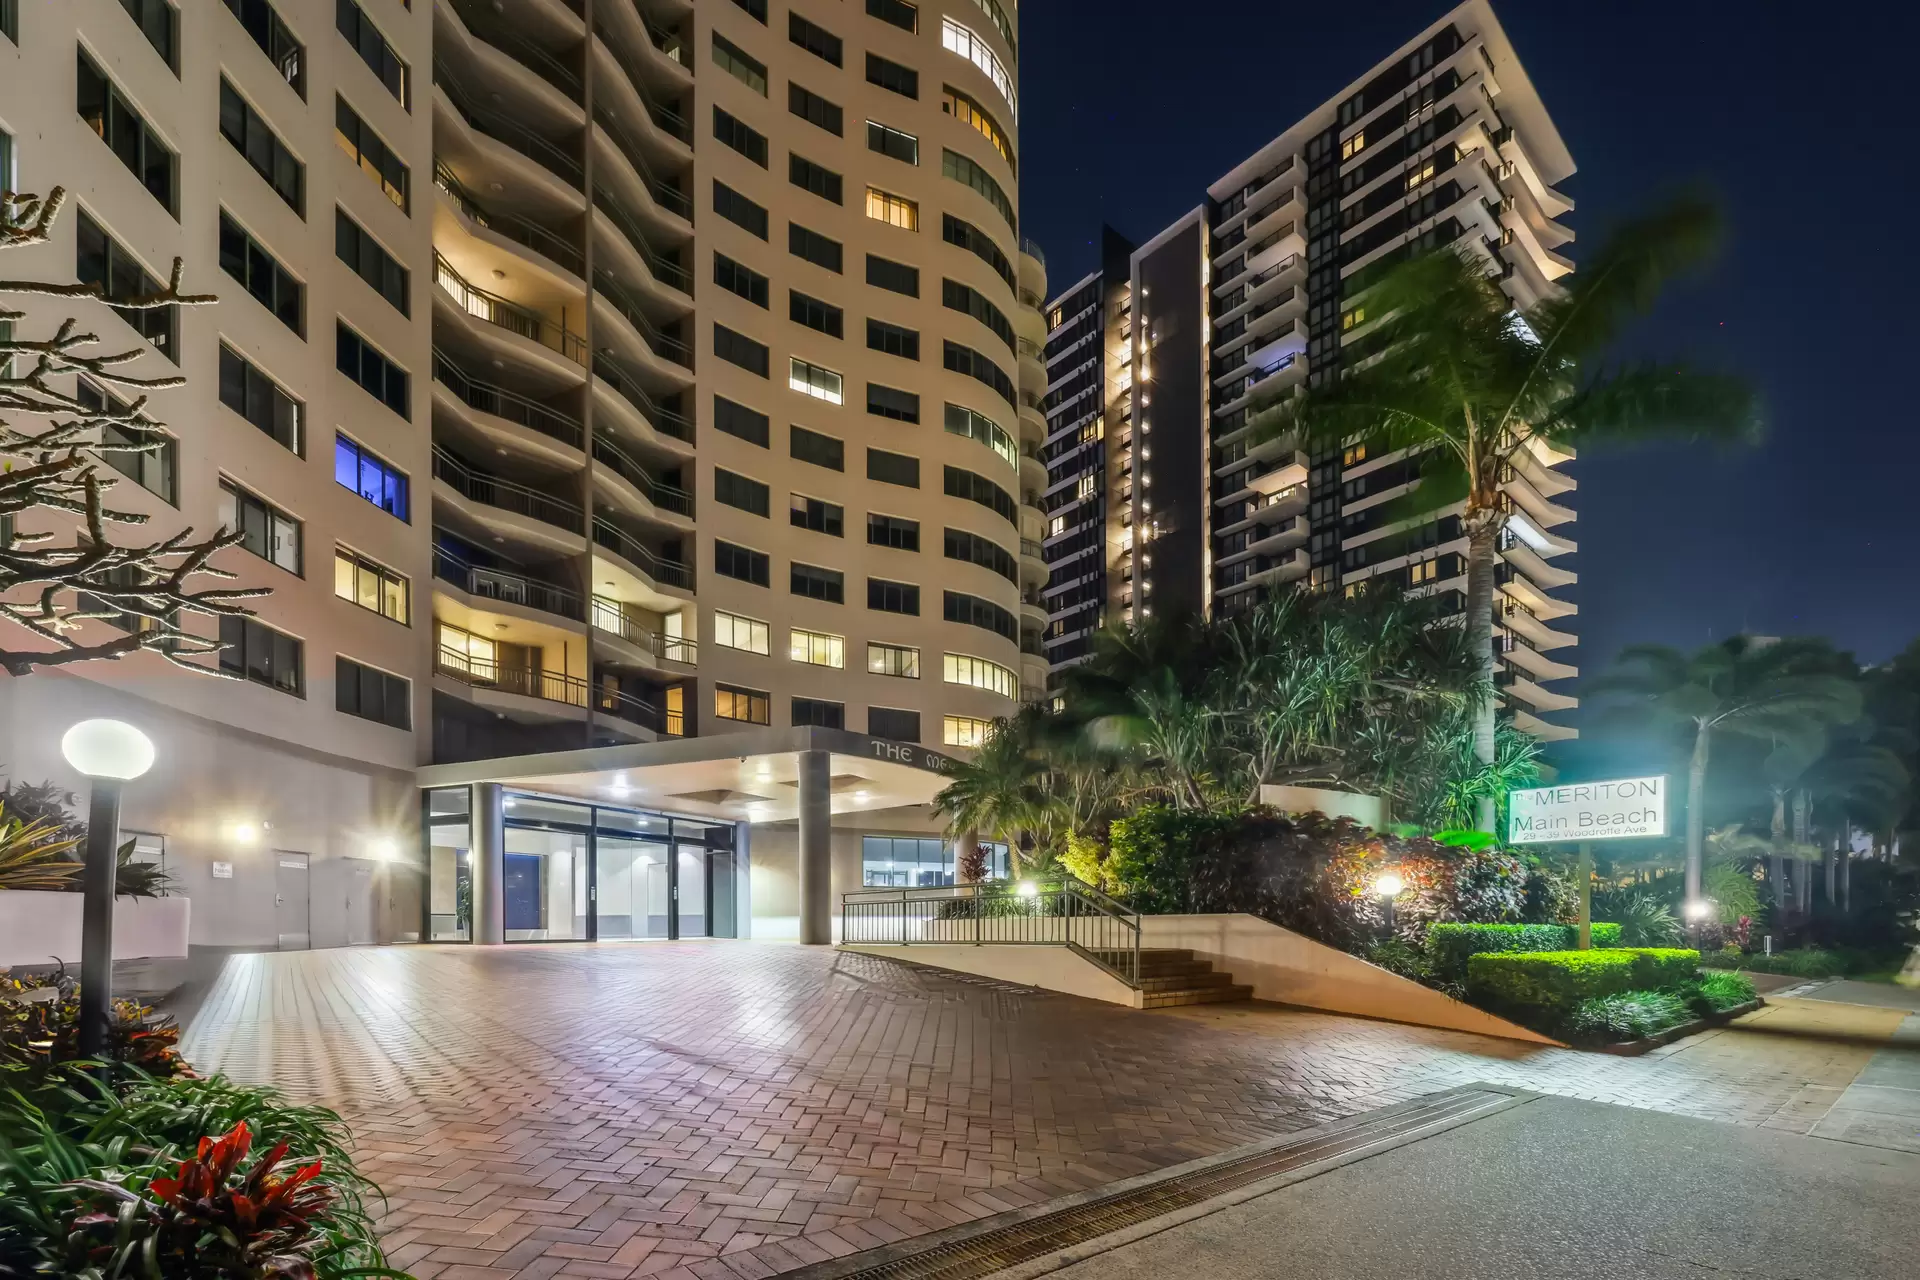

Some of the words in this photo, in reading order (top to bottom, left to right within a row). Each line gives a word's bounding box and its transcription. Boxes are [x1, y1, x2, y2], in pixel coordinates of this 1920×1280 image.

[870, 740, 913, 762] THE
[1535, 779, 1657, 806] MERITON
[1515, 814, 1568, 832] Main
[1578, 807, 1657, 827] Beach
[1523, 832, 1536, 840] 29
[1546, 831, 1560, 839] 39
[1623, 825, 1647, 834] Ave
